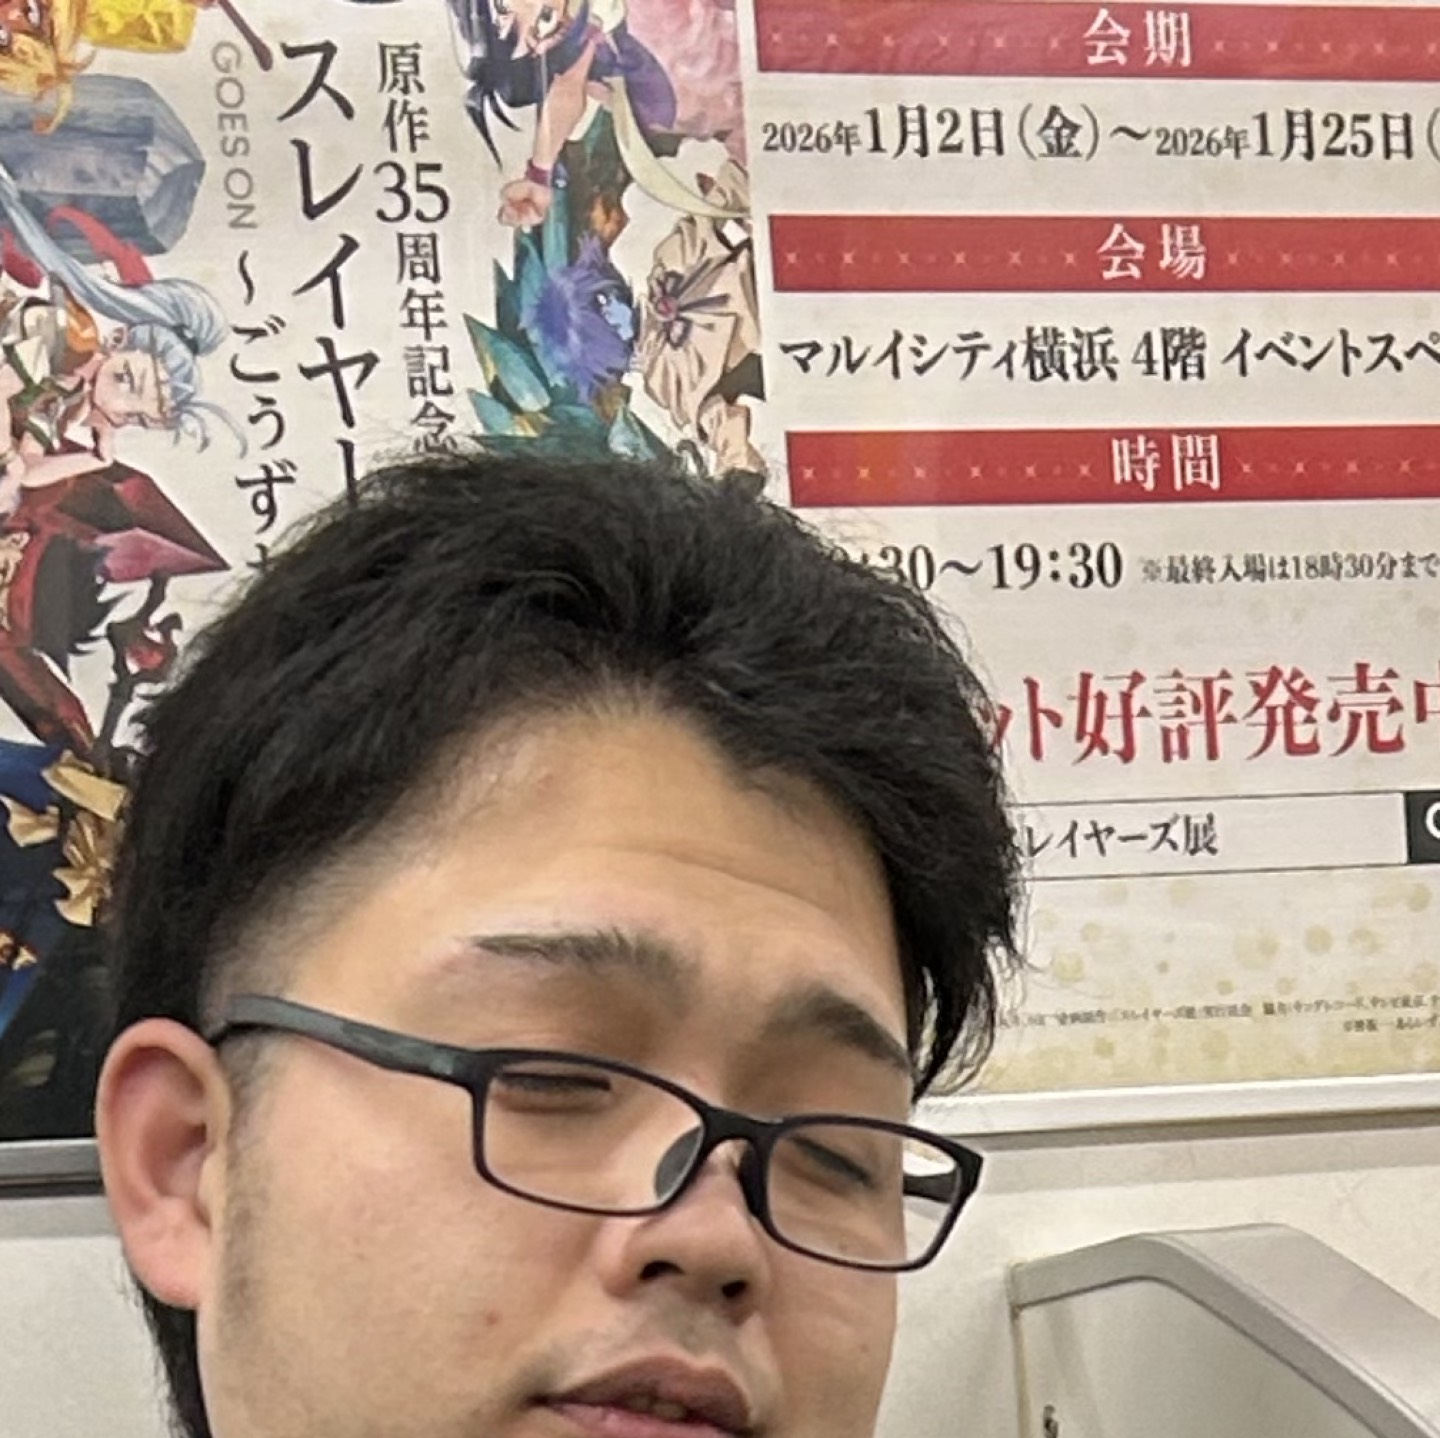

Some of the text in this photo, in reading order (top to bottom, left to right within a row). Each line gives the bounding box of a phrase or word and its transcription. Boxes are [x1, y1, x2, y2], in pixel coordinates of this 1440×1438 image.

[1083, 8, 1192, 67] 会期
[210, 40, 250, 159] GOES
[221, 170, 259, 231] ON
[372, 41, 458, 453] 原作35周年記念
[1096, 223, 1206, 281] 会場
[777, 325, 1120, 383] マルイシティ横浜
[1131, 326, 1207, 382] 4階
[1110, 433, 1221, 491] 時間
